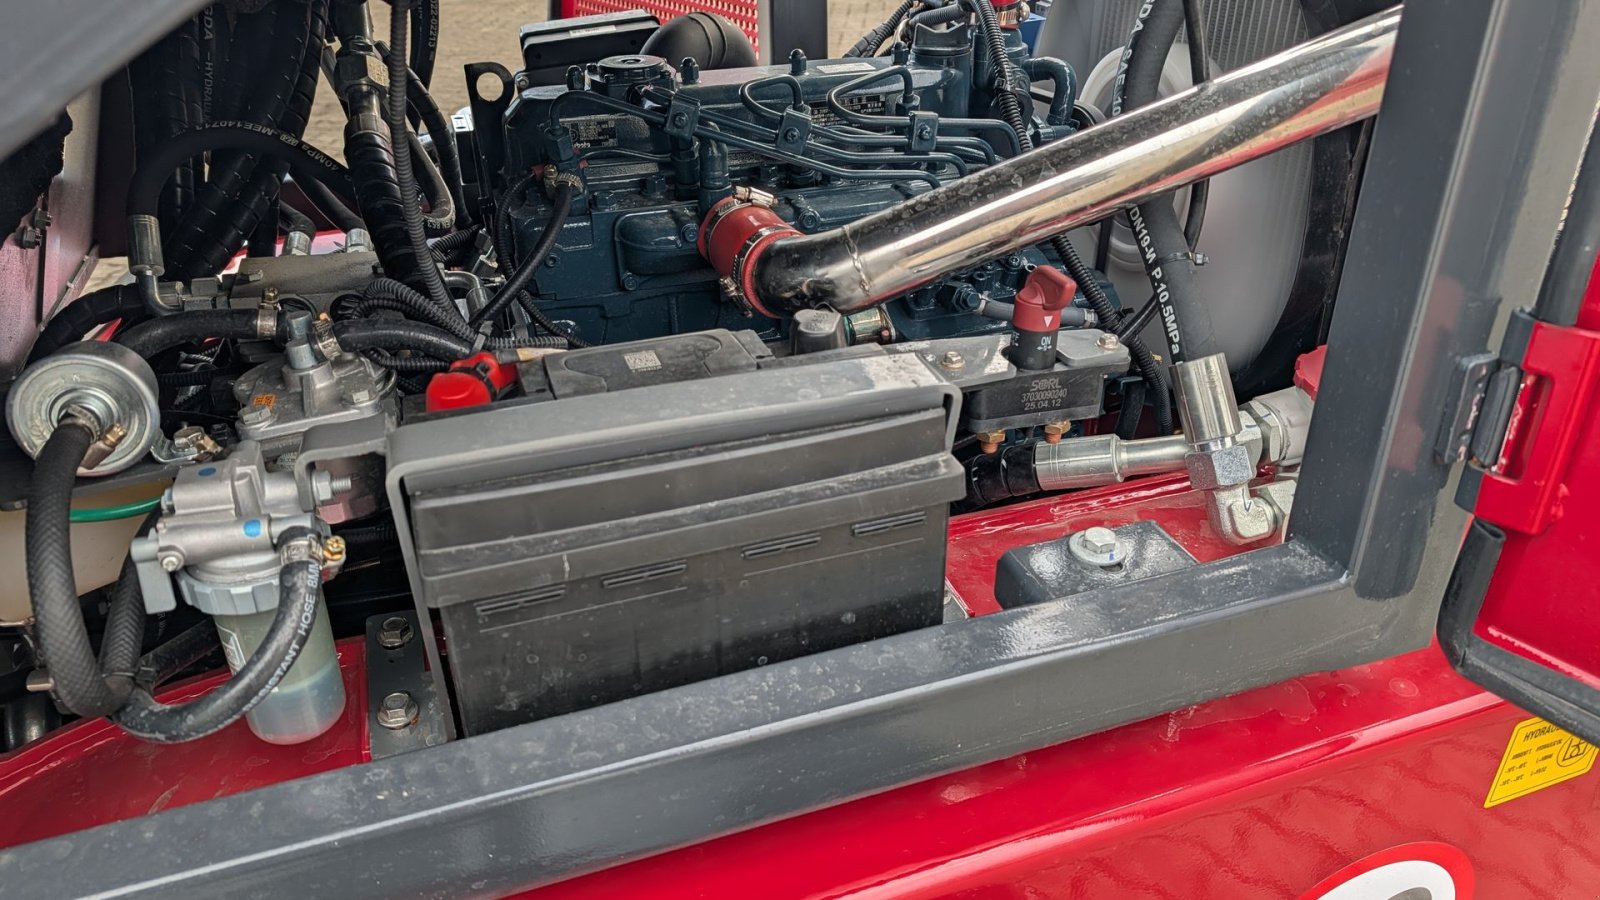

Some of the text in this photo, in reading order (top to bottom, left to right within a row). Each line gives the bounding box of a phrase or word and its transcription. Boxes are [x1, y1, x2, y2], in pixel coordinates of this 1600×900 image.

[1041, 336, 1052, 346] ON
[1024, 399, 1061, 410] 25.04.12
[298, 594, 316, 636] HOSE
[1523, 725, 1560, 742] HYDRAU
